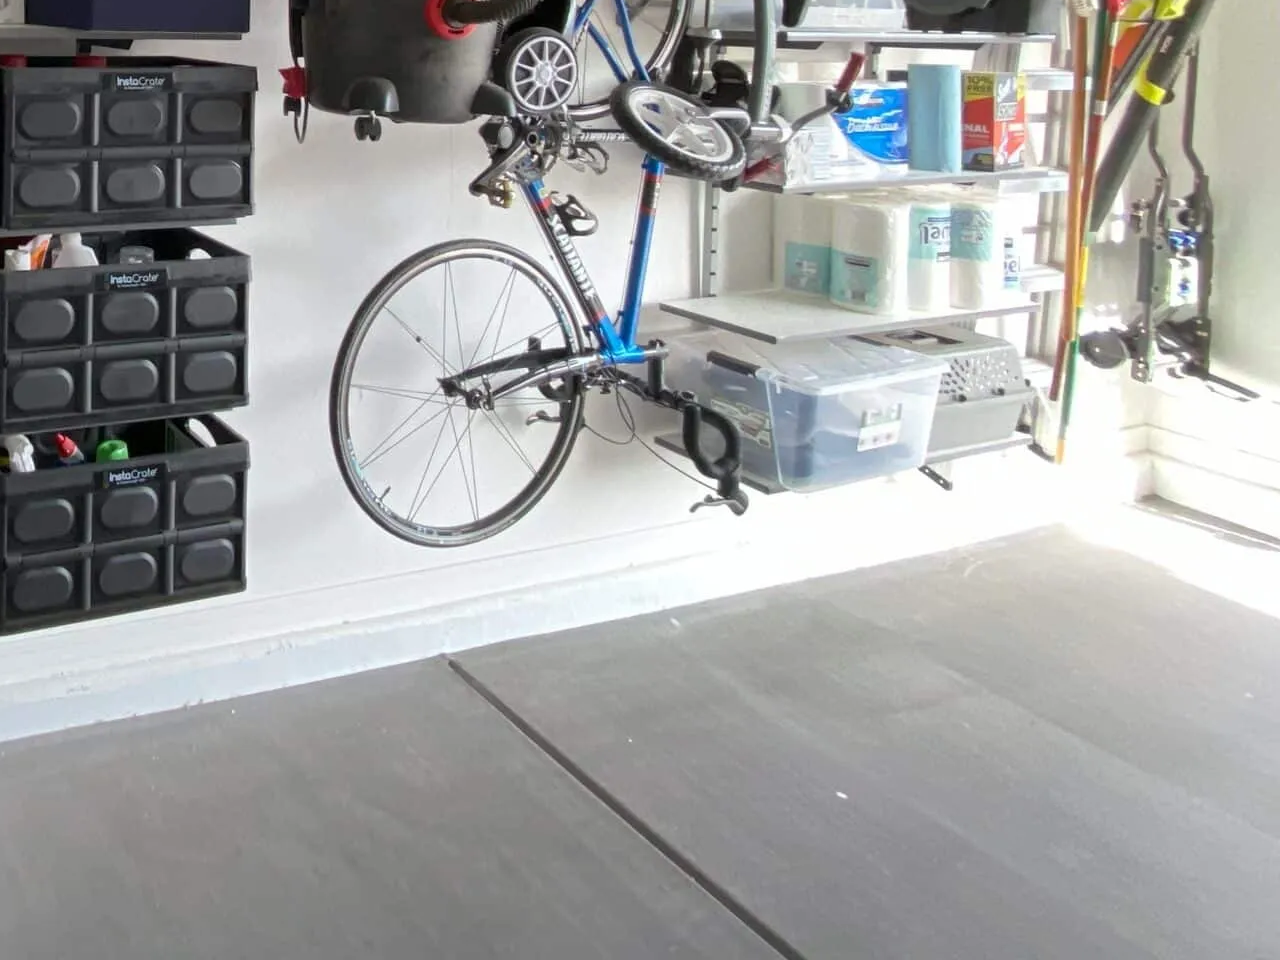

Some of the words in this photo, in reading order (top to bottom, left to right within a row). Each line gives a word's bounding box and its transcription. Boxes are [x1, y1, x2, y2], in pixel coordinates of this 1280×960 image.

[117, 76, 164, 86] InstaCrate
[110, 271, 159, 284] InstaCrate
[109, 467, 158, 482] InstaCrate
